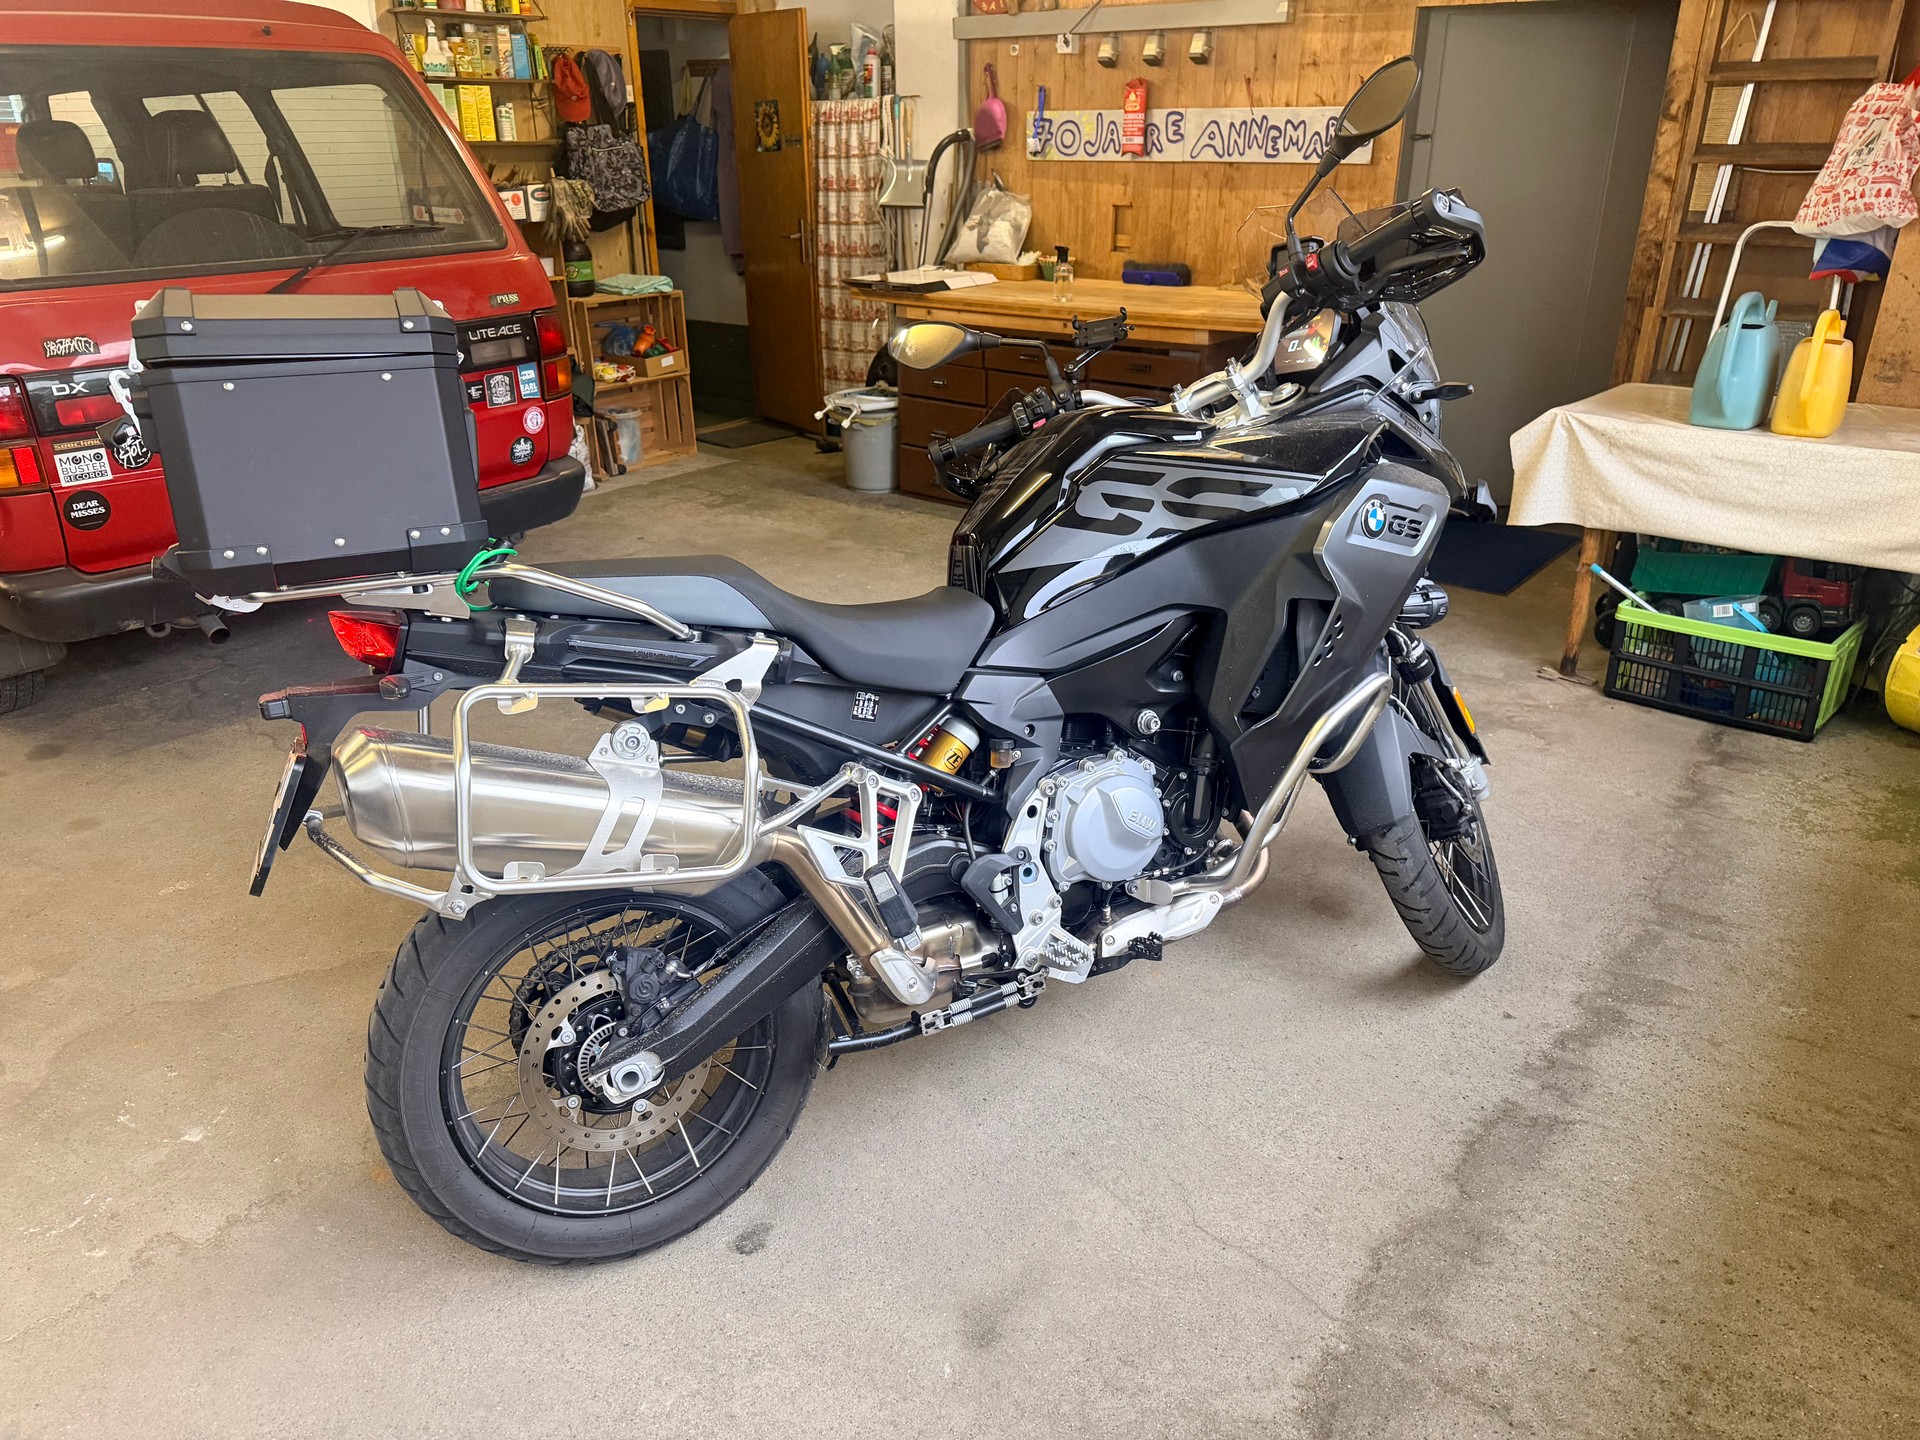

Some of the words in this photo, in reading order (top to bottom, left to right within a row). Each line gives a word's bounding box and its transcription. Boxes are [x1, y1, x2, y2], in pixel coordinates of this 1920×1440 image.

[1083, 111, 1184, 157] JARE
[52, 381, 89, 396] DX
[58, 451, 103, 468] MONO
[61, 461, 107, 476] BUSTER
[63, 469, 109, 484] RECORDS
[70, 506, 106, 519] MISSES
[72, 499, 99, 511] DEAR
[1388, 514, 1424, 540] GS
[946, 752, 963, 770] ZF
[1127, 808, 1157, 832] BMW
